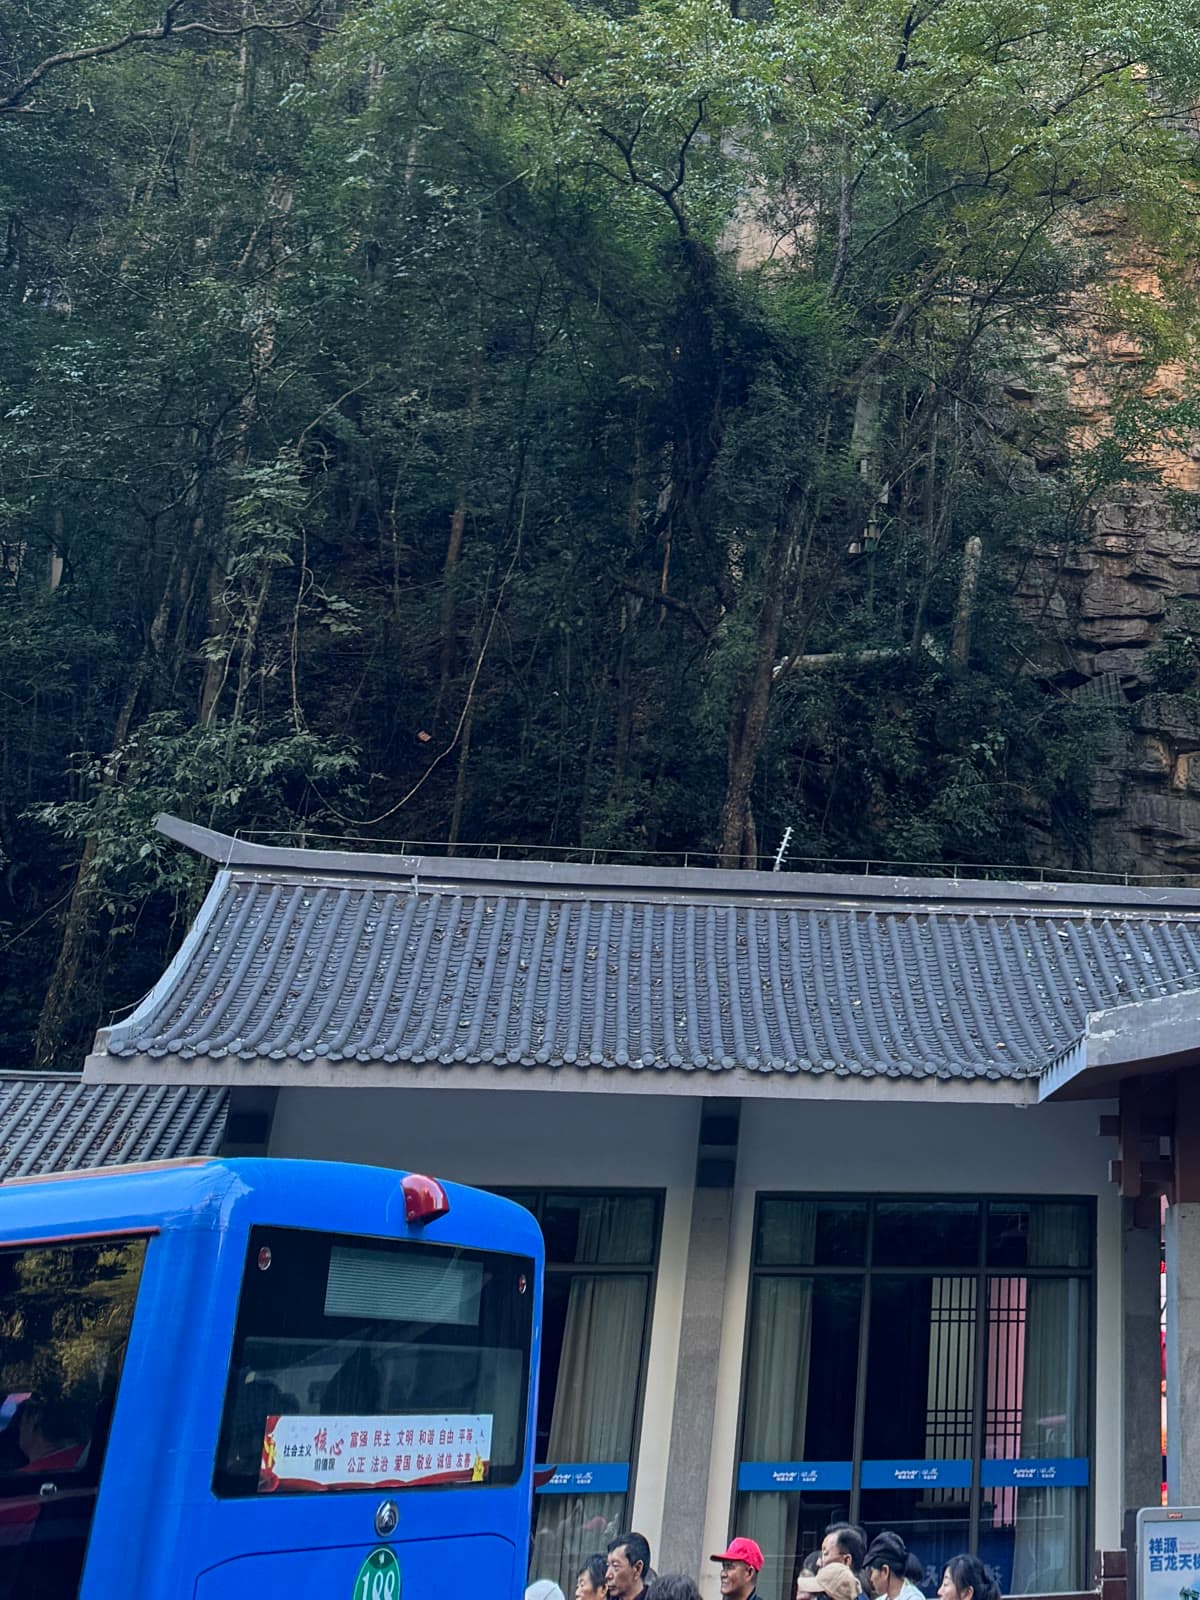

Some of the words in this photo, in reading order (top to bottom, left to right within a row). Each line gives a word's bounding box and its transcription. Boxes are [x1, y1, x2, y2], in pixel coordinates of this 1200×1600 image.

[350, 1431, 368, 1448] 富强
[373, 1430, 391, 1446] 民主
[396, 1430, 413, 1446] 文明
[419, 1430, 434, 1446] 和谐
[439, 1429, 454, 1445] 自由
[458, 1428, 473, 1444] 平等
[283, 1444, 312, 1457] 社会主义
[347, 1456, 366, 1473] 公正
[370, 1456, 388, 1472] 法治
[394, 1454, 411, 1471] 爱国
[416, 1453, 432, 1470] 敬业
[437, 1453, 452, 1469] 诚信
[455, 1452, 471, 1468] 友善
[1149, 1537, 1178, 1554] 祥源
